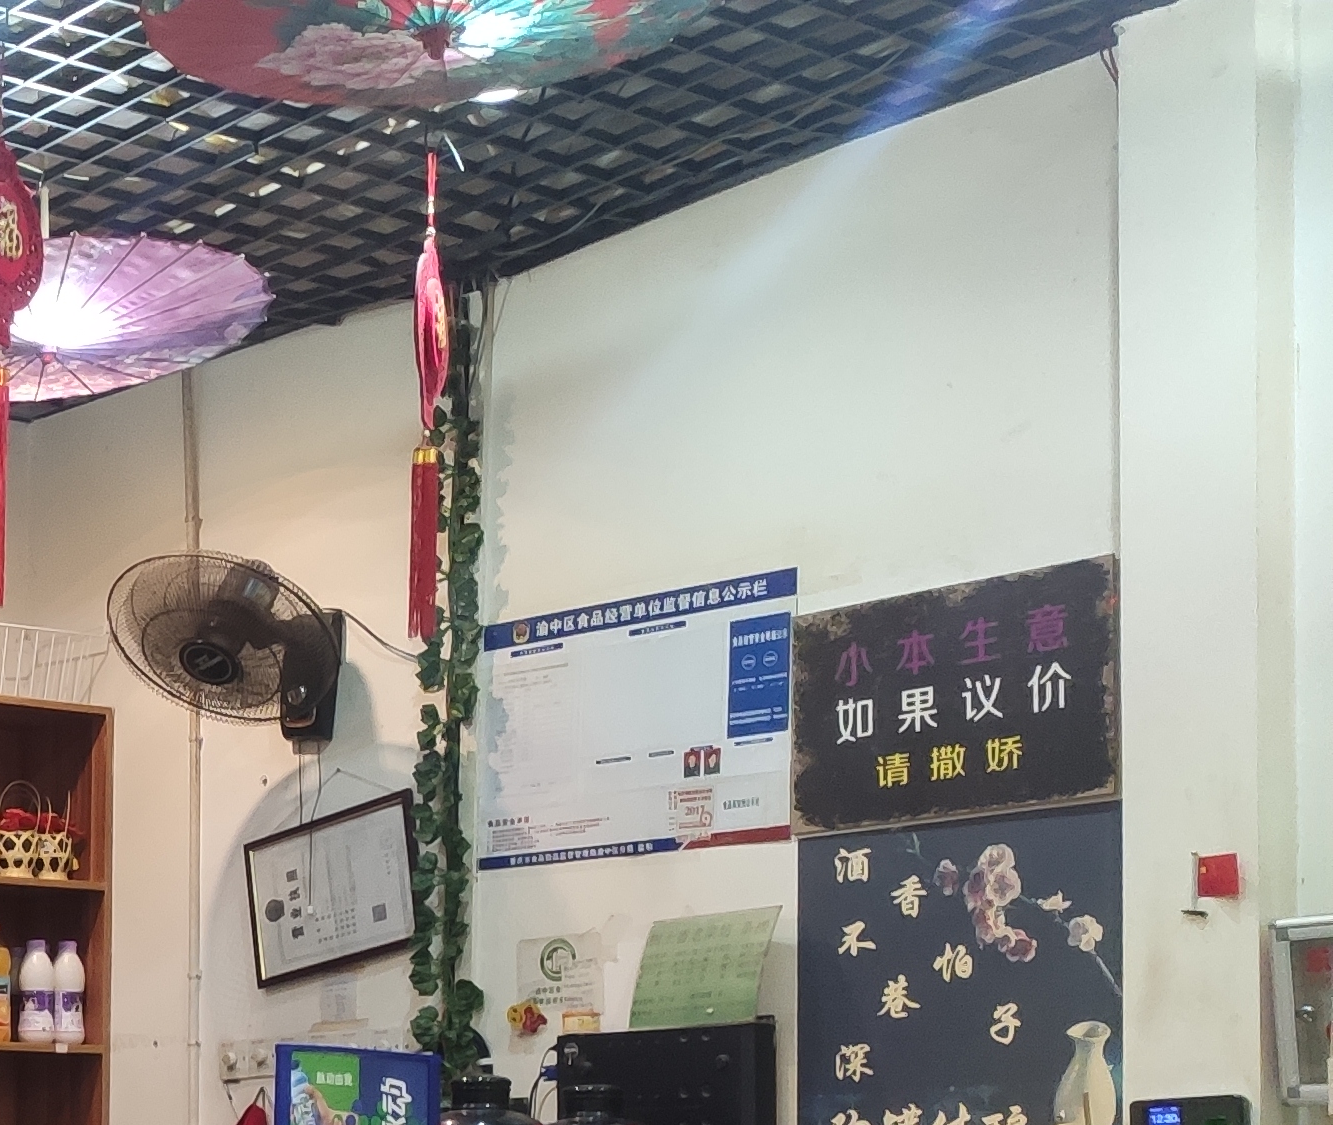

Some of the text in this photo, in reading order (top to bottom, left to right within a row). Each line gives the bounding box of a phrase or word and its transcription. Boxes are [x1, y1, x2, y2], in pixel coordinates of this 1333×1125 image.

[535, 578, 769, 637] 渝中区食品经营单位监督信息公示栏
[835, 603, 1069, 688] 小本生意
[835, 661, 1072, 745] 如果议价
[875, 734, 1023, 789] 请撒娇
